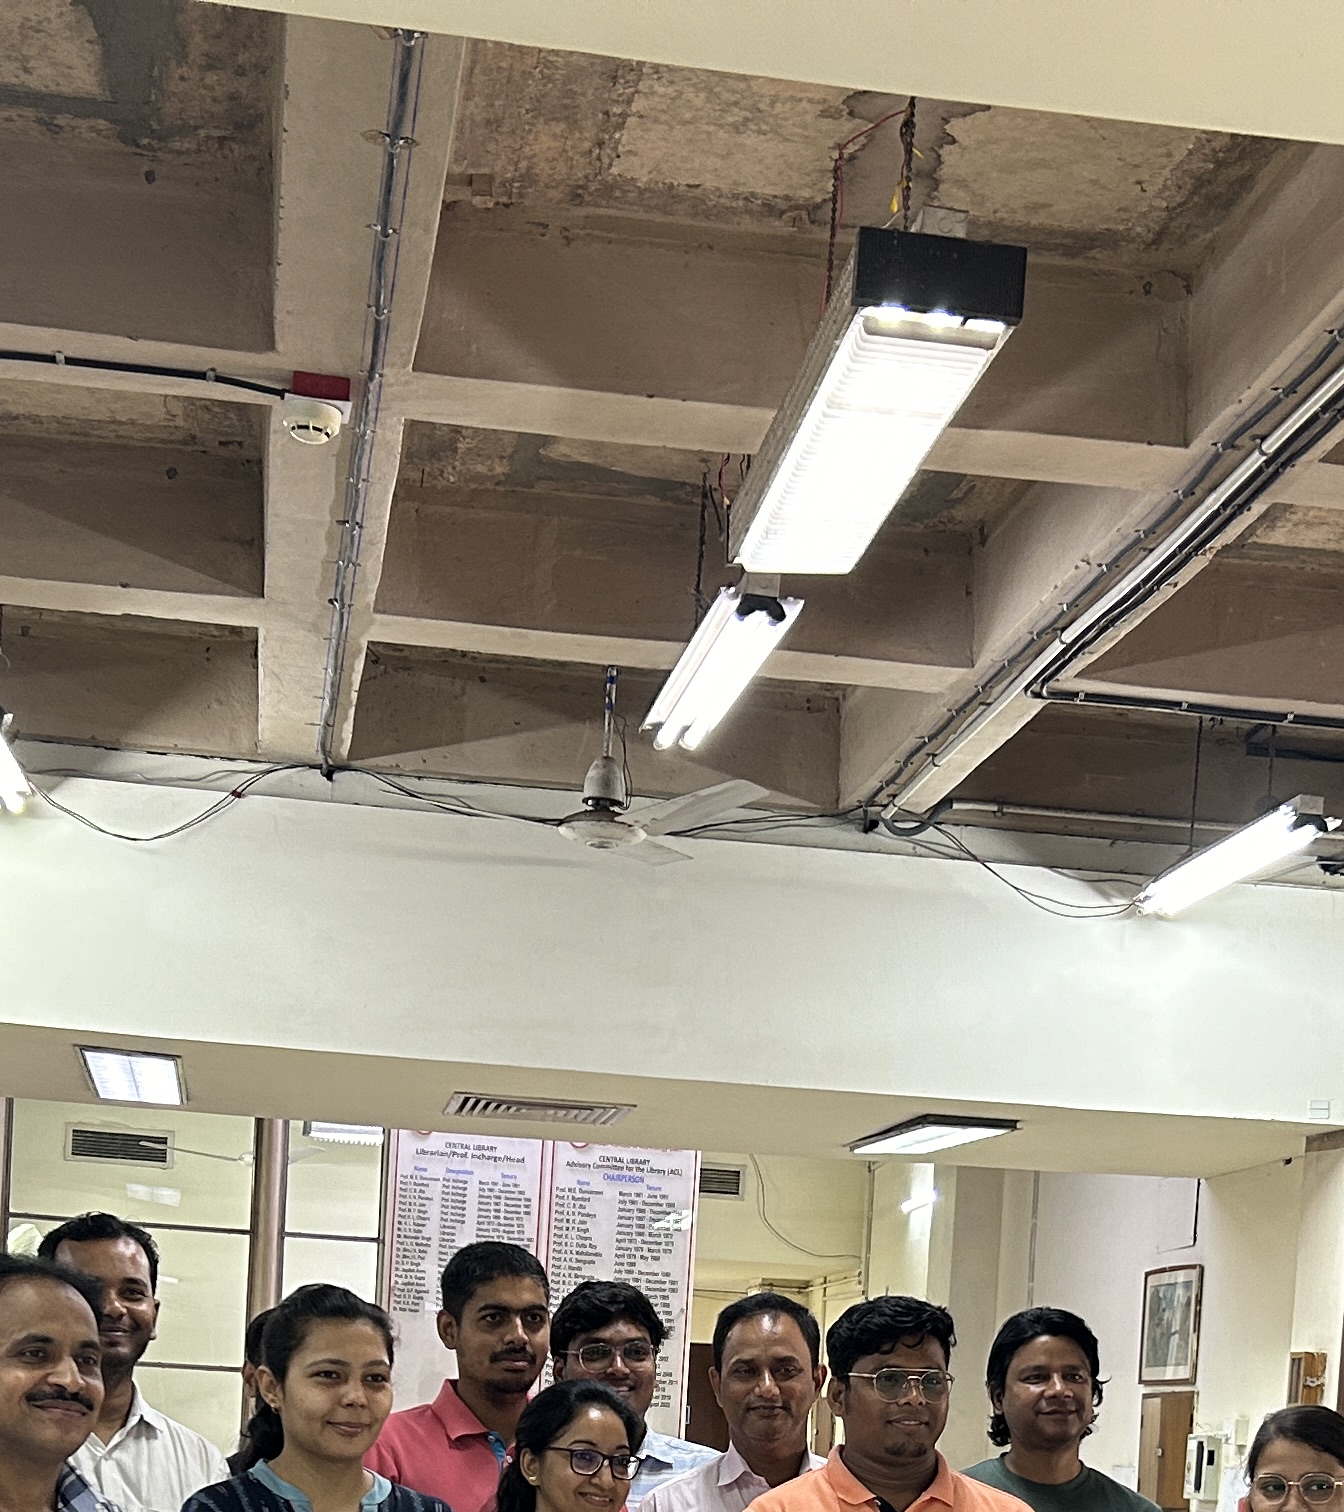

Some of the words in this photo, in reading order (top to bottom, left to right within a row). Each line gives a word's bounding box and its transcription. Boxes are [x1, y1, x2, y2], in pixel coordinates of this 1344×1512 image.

[445, 1142, 471, 1150] CENTRAL
[473, 1144, 497, 1152] LIBRARY
[599, 1155, 624, 1164] CENTRAL
